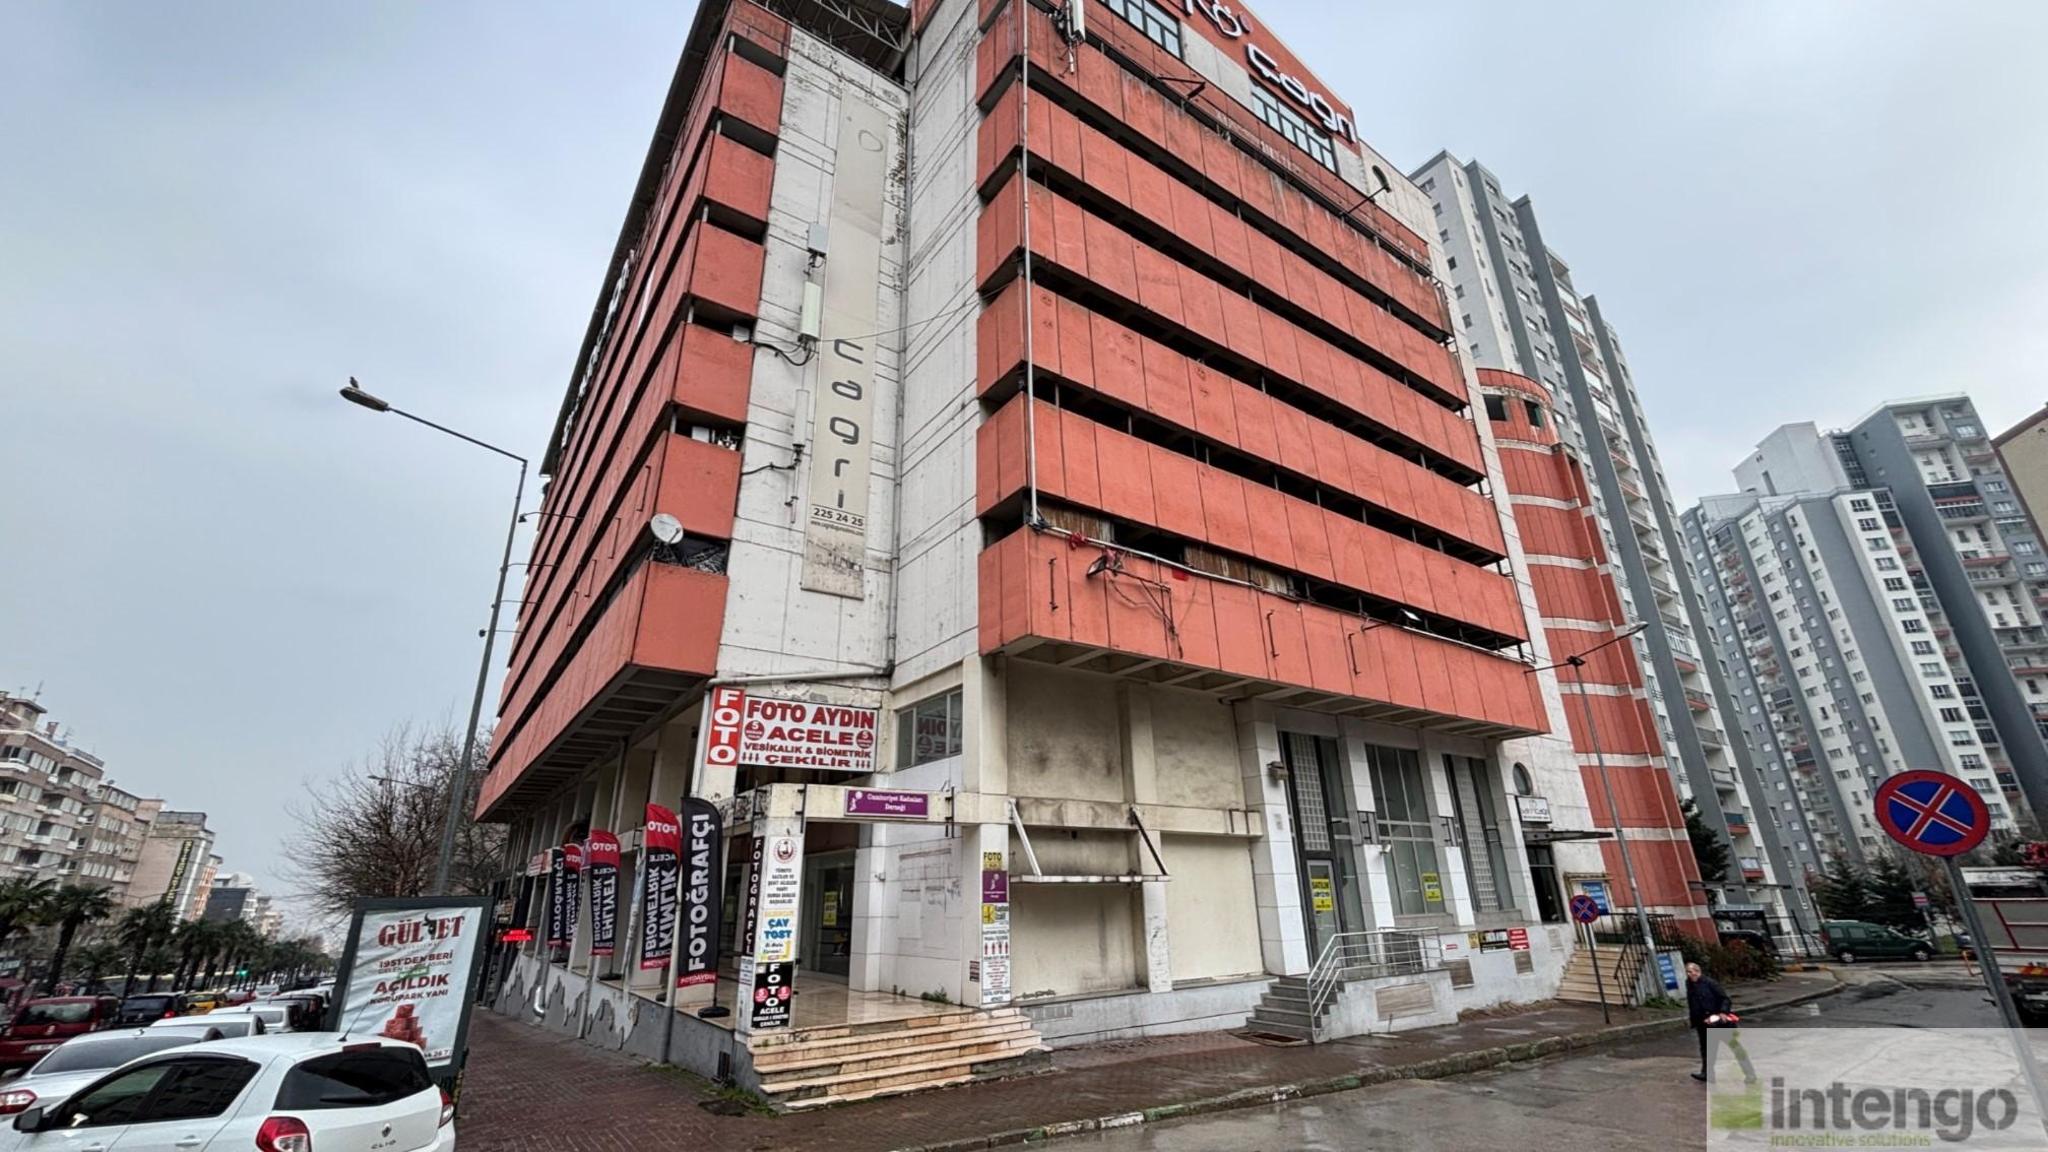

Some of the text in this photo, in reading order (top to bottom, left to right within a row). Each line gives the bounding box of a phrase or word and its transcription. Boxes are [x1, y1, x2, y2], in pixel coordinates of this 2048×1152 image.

[813, 507, 864, 527] 225 24 25
[746, 700, 874, 730] FOTO AYDIN
[709, 689, 741, 763] FOTO
[767, 726, 854, 746] ACELE
[744, 741, 872, 759] VESİKALIK & BİOMETRİK
[765, 754, 851, 768] ÇEKİLİR
[983, 852, 1002, 861] FOTO
[685, 814, 715, 971] FOTOĞRAFÇI
[768, 918, 790, 929] ÇAY
[764, 930, 792, 939] TOST
[373, 973, 451, 995] AÇILDIK
[426, 989, 448, 998] YANI
[765, 963, 780, 1007] FOTO
[760, 1006, 785, 1015] ACELE
